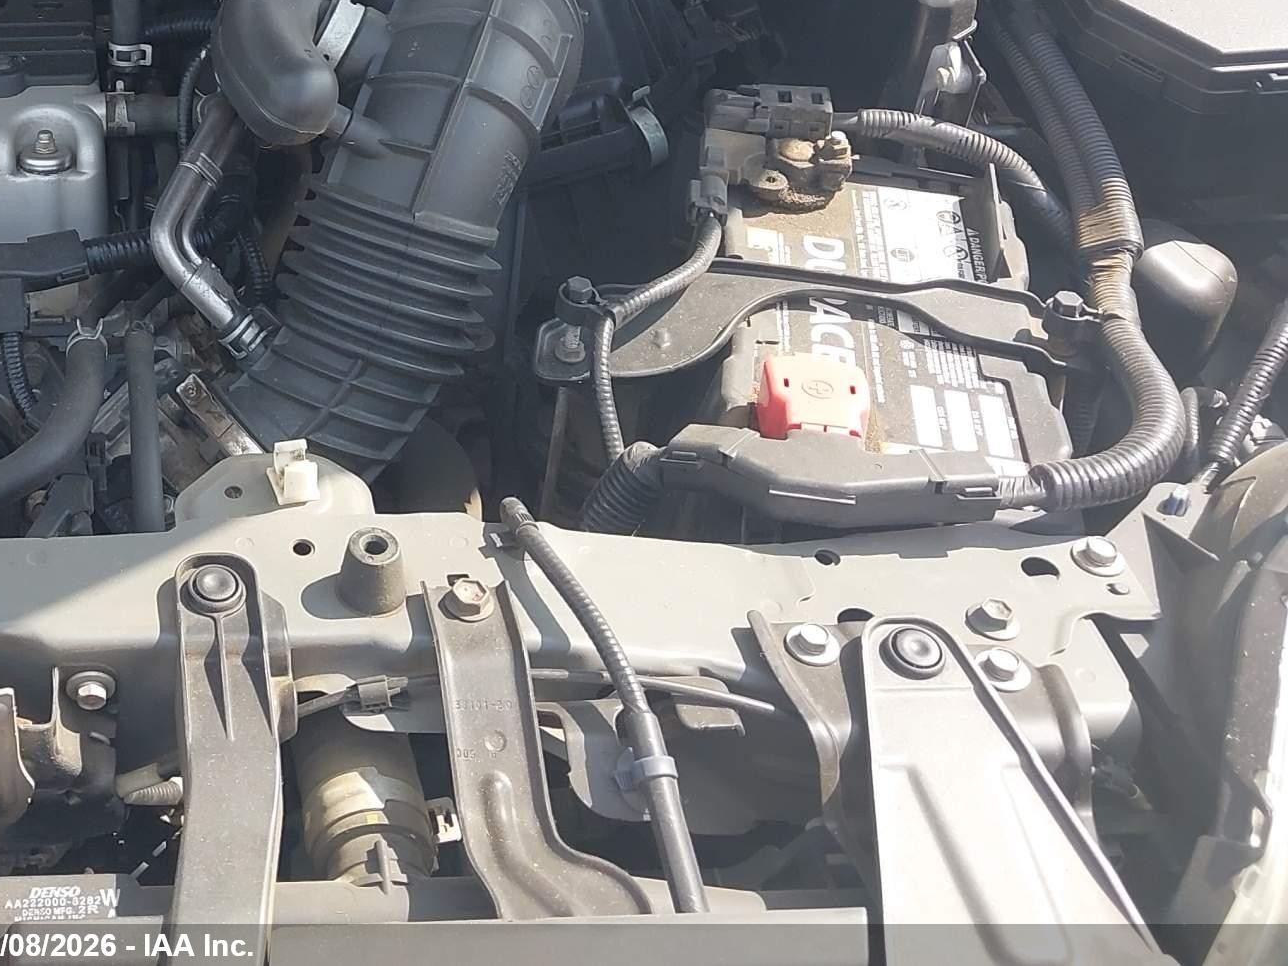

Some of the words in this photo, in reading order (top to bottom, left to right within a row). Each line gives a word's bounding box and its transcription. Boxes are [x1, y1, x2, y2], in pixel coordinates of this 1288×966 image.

[29, 885, 81, 899] DENSO
[99, 888, 121, 907] W
[22, 907, 52, 917] DENSO
